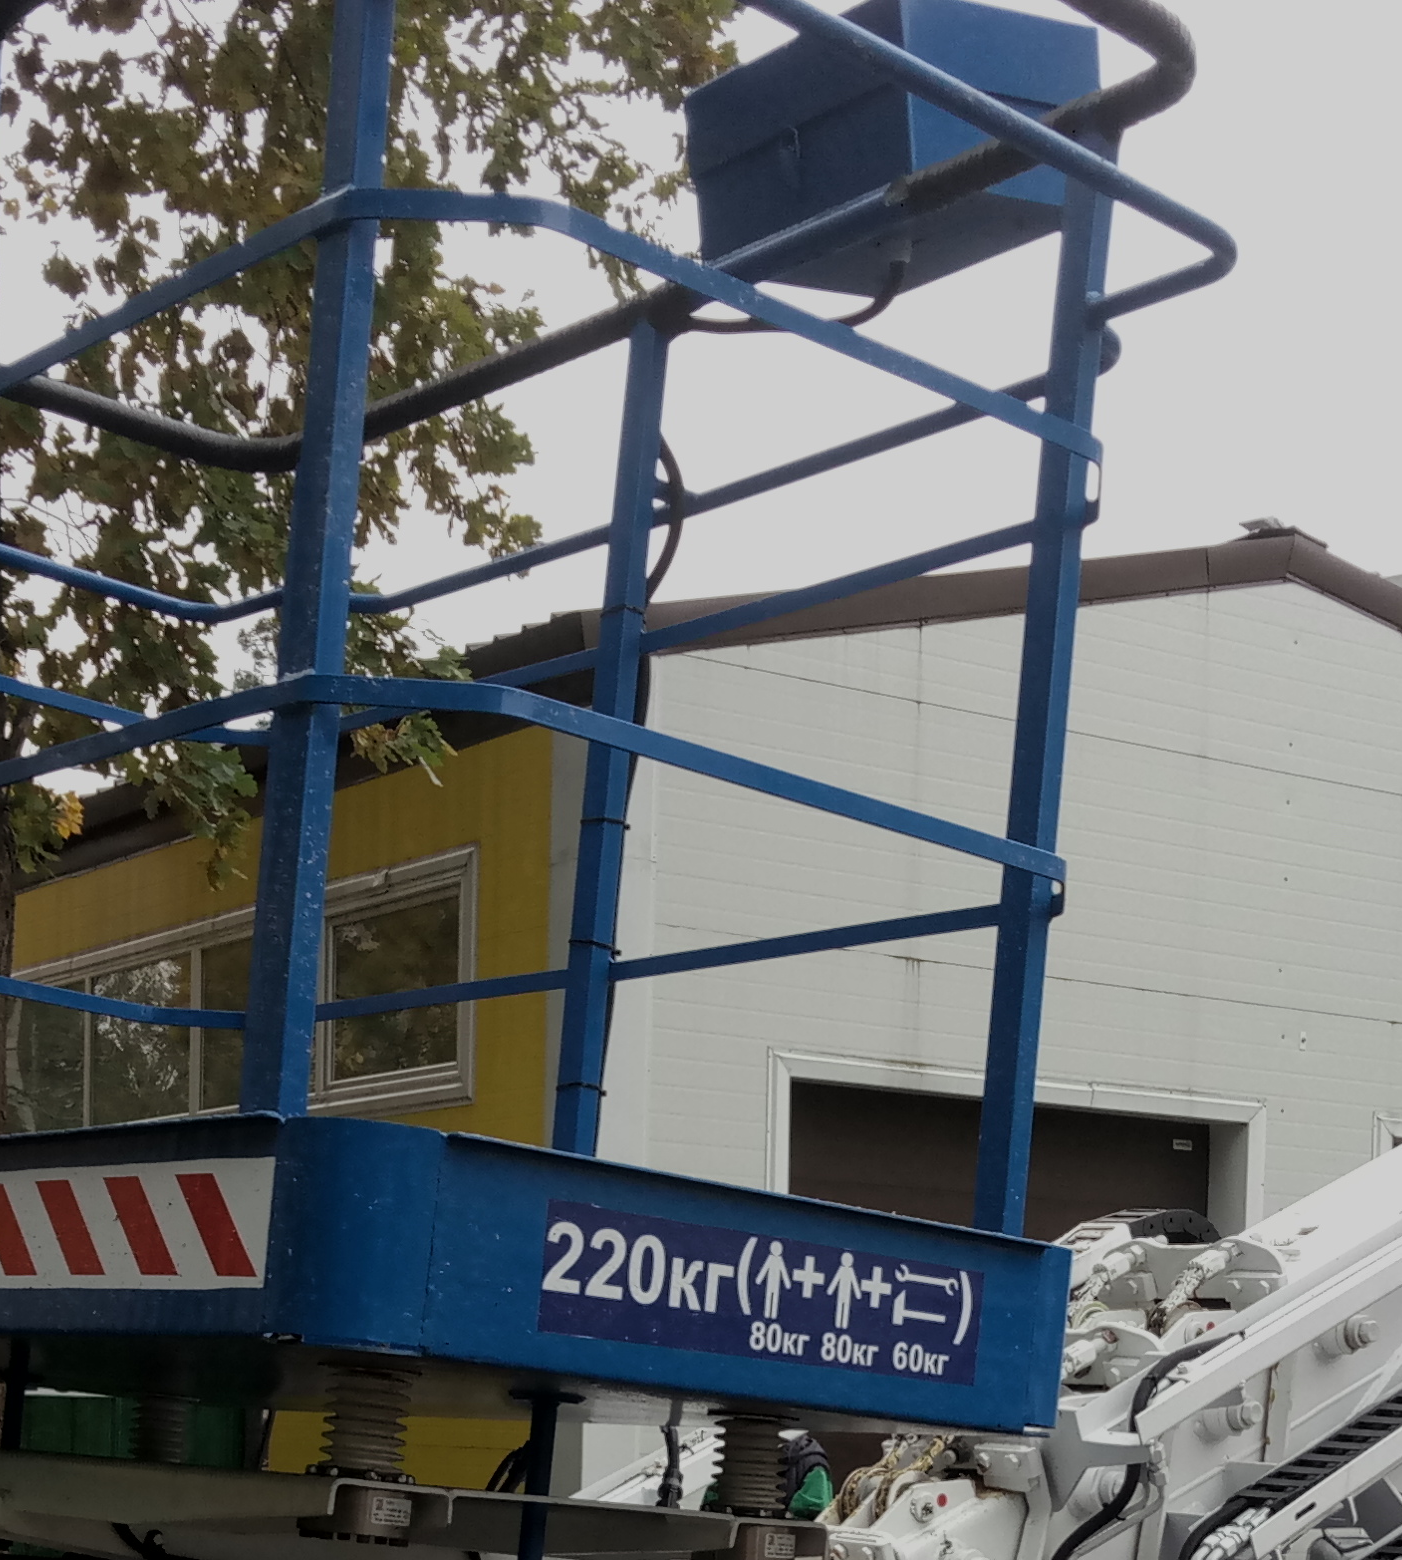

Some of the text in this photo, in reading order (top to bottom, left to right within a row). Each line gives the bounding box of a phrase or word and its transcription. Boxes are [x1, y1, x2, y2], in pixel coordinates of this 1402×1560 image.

[749, 1321, 949, 1377] 80кг 80кг 60кг
